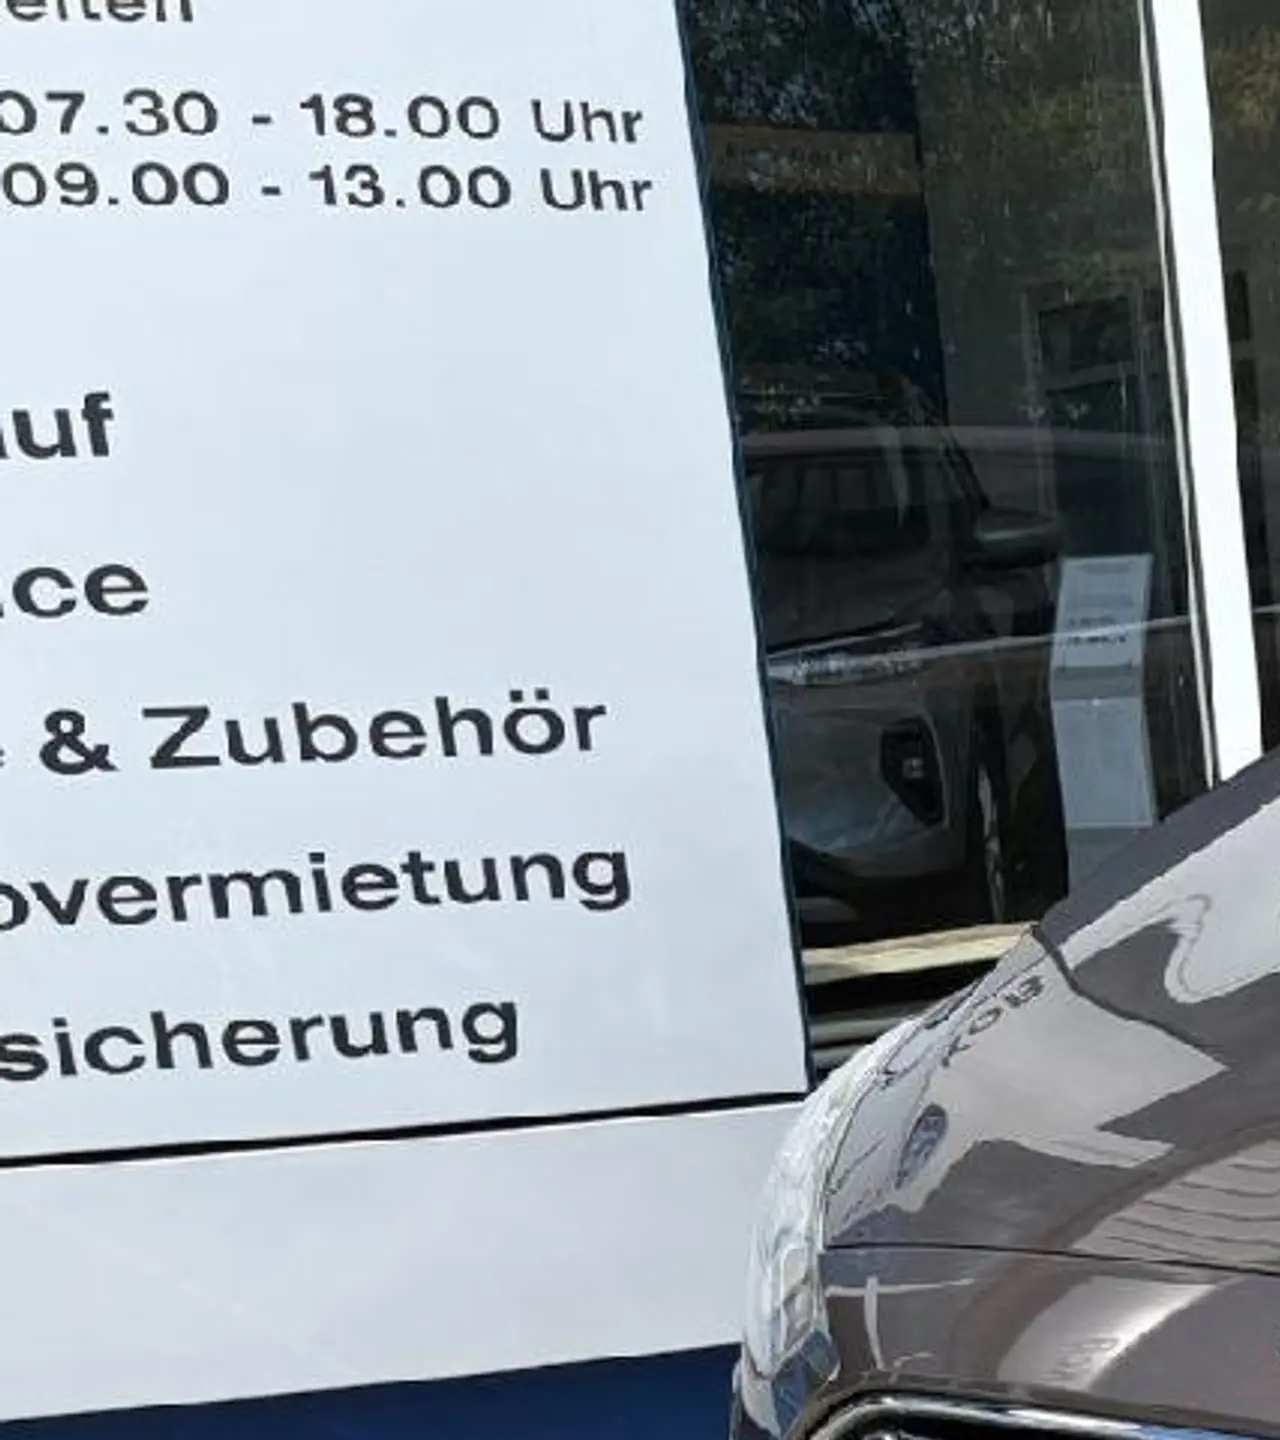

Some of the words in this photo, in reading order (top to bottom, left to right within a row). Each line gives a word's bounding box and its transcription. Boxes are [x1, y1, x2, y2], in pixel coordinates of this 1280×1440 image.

[0, 89, 218, 136] 07.30
[251, 115, 272, 125] -
[300, 93, 500, 139] 18.00
[531, 99, 643, 143] Uhr
[1, 161, 230, 206] 09.00
[261, 186, 281, 196] -
[309, 163, 512, 209] 13.00
[540, 168, 653, 211] Uhr
[0, 391, 114, 459] uf
[0, 563, 149, 618] ce
[38, 708, 119, 775] &
[141, 688, 607, 769] Zubehör
[0, 1001, 518, 1082] sicherung
